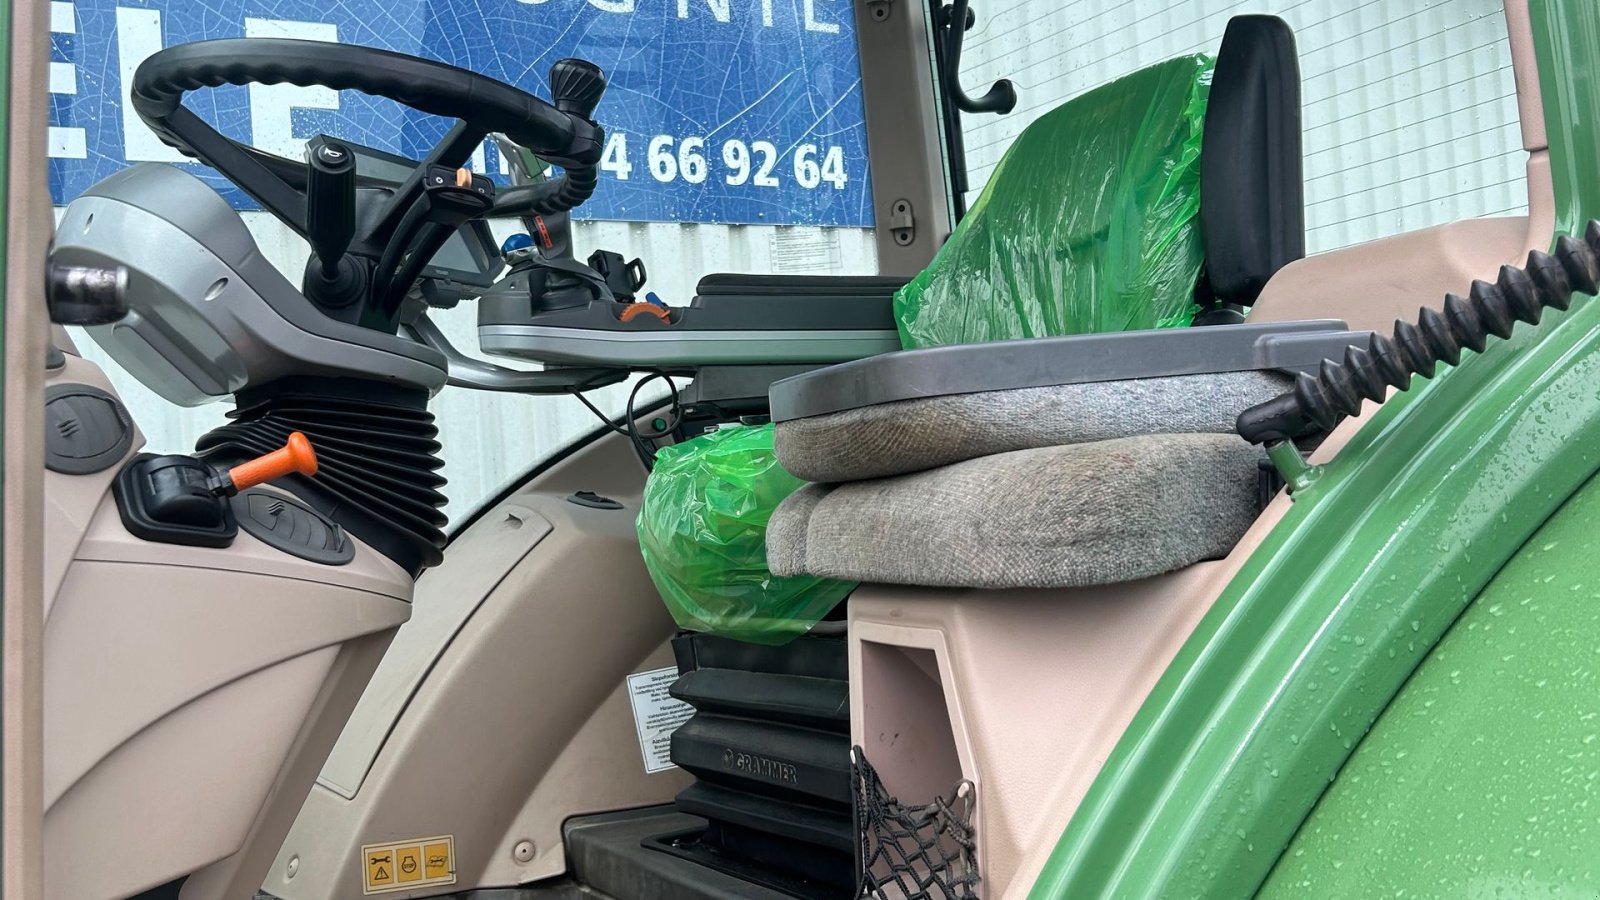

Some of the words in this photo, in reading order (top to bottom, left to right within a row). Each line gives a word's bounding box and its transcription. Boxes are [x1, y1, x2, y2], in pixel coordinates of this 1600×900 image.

[601, 132, 632, 180] 4
[648, 135, 708, 184] 66
[722, 139, 780, 188] 92
[793, 144, 848, 190] 64
[737, 752, 797, 784] GRAMMER
